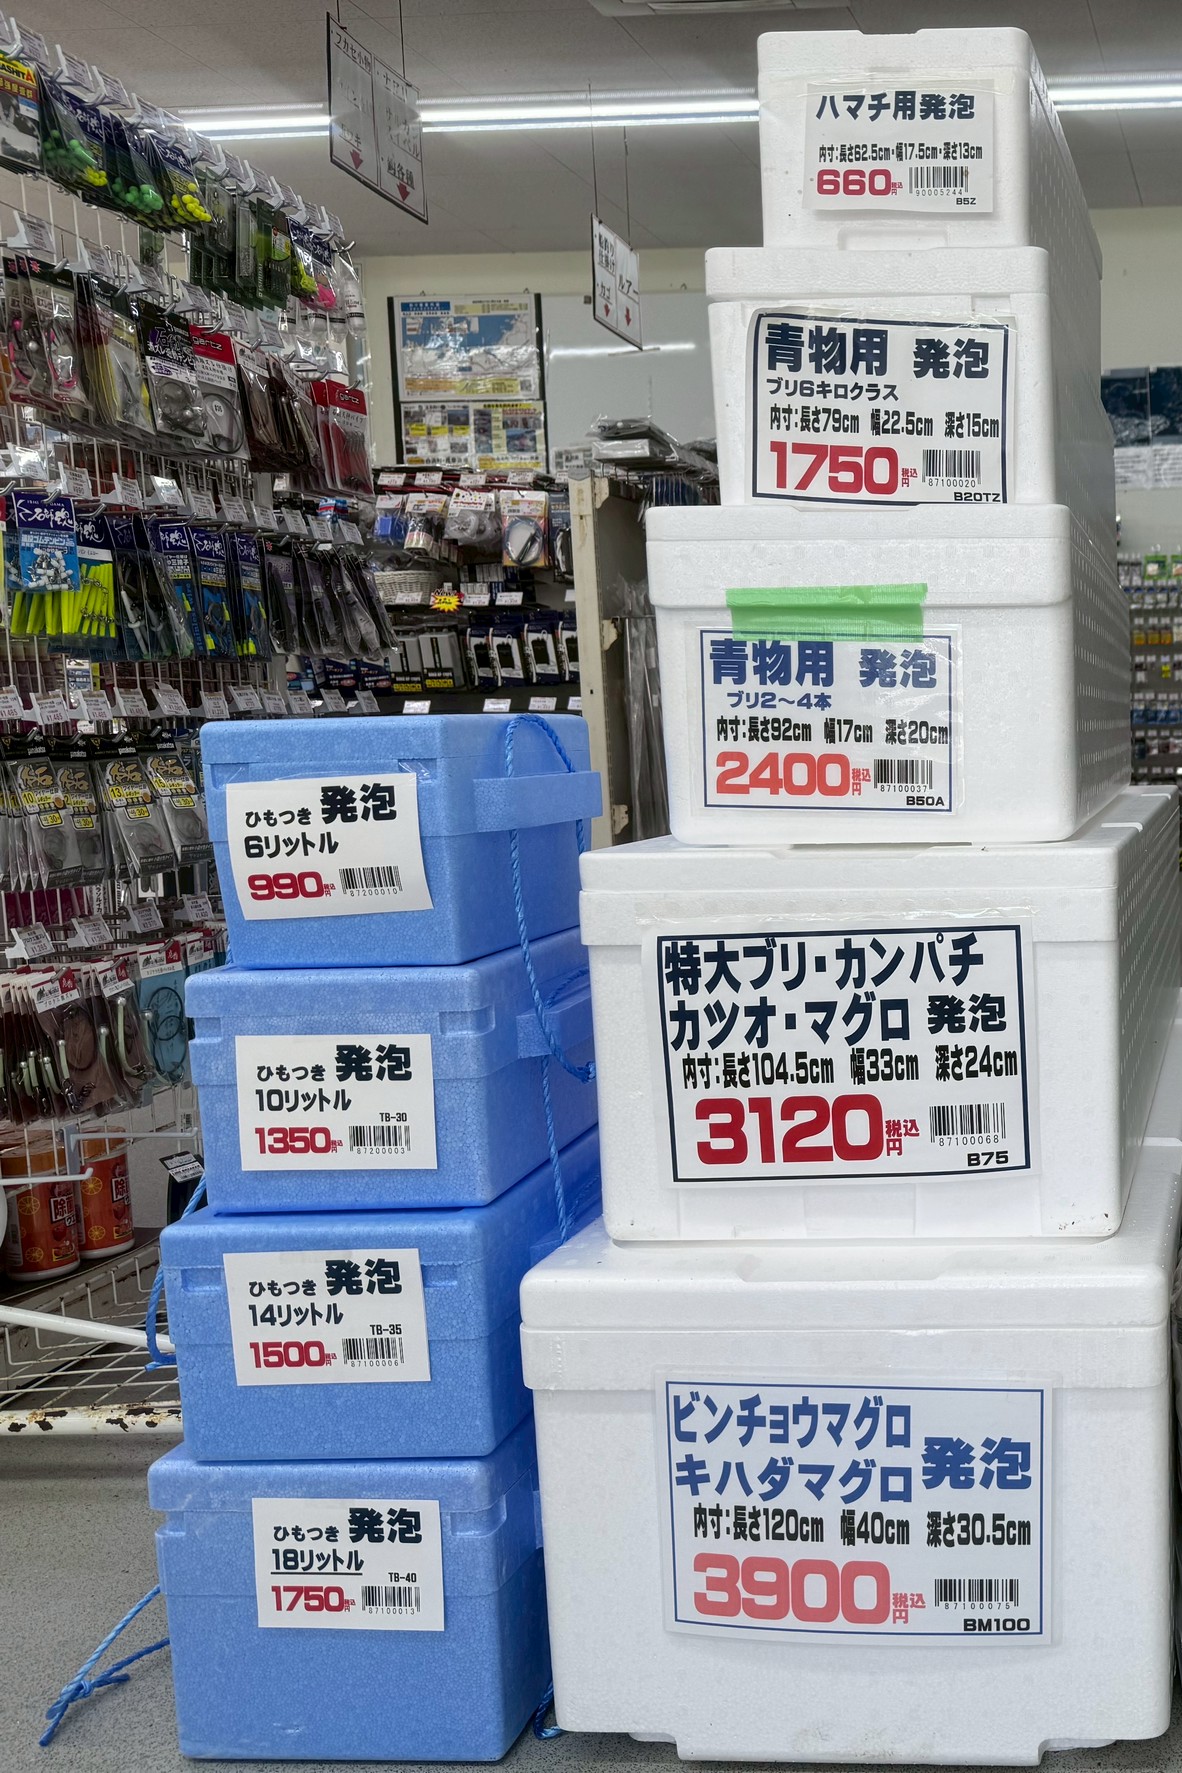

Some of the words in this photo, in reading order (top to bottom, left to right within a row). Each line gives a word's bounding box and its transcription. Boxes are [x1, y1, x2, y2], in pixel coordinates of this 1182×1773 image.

[816, 91, 974, 121] ハマチ用発泡
[817, 169, 891, 195] 660
[766, 323, 888, 376] 青物用
[913, 338, 989, 379] 発泡
[767, 377, 899, 401] ブリ6キロクラス
[770, 404, 859, 433] 内寸:長さ79cm
[871, 409, 933, 436] 幅22.5cm
[945, 412, 999, 438] 深さ15cm
[770, 441, 898, 494] 1750
[929, 478, 976, 487] 87100020
[954, 492, 1000, 502] B20TZ
[710, 639, 834, 687] 青物用
[859, 649, 937, 688] 発泡
[717, 716, 811, 742] 内寸:長さ92cm
[824, 718, 872, 743] 幅17cm
[885, 719, 948, 744] 深さ20cm
[154, 780, 165, 788] 15
[716, 752, 850, 796] 2400
[852, 769, 871, 782] 税込
[23, 793, 33, 804] 10
[110, 788, 121, 798] 13
[852, 782, 861, 796] 円
[906, 797, 944, 806] B50A
[245, 808, 311, 827] ひもつき
[321, 783, 396, 824] 発泡
[244, 832, 339, 858] 6リットル
[248, 872, 324, 900] 990
[665, 932, 983, 995] 特大ブリ・カンパチ
[670, 991, 909, 1051] カツオ・マグロ
[927, 993, 1006, 1034] 発泡
[257, 1064, 325, 1081] ひもつき
[335, 1045, 412, 1081] 発泡
[682, 1052, 834, 1089] 内寸:長さ104.5cm
[850, 1048, 919, 1084] 幅33cm
[935, 1044, 1018, 1082] 深さ24cm
[256, 1088, 352, 1112] 10リットル
[379, 1113, 407, 1122] TB-30
[696, 1094, 883, 1165] 3120
[885, 1119, 919, 1137] 税込
[255, 1127, 331, 1154] 1350
[886, 1139, 902, 1156] 円
[939, 1135, 999, 1147] 87100068
[967, 1151, 1009, 1166] B75
[249, 1280, 316, 1297] ひもつき
[325, 1259, 402, 1295] 発泡
[249, 1303, 343, 1326] 14リットル
[370, 1324, 402, 1335] TB-35
[250, 1341, 324, 1368] 1500
[674, 1391, 911, 1450] ビンチョウマグロ
[676, 1454, 912, 1504] キハダマグロ
[922, 1437, 1031, 1490] 発泡
[274, 1526, 339, 1542] ひもつき
[348, 1508, 422, 1543] 発泡
[694, 1503, 824, 1542] 内寸:長さ120cm
[841, 1510, 909, 1546] 幅40cm
[926, 1511, 1031, 1547] 深さ30.5cm
[272, 1549, 364, 1571] 18リットル
[388, 1573, 416, 1582] TB-40
[694, 1553, 890, 1624] 3900
[892, 1593, 926, 1609] 税込
[272, 1586, 344, 1612] 1750
[369, 1607, 414, 1615] 87100013
[892, 1610, 908, 1624] 円
[963, 1618, 1030, 1632] BM100
